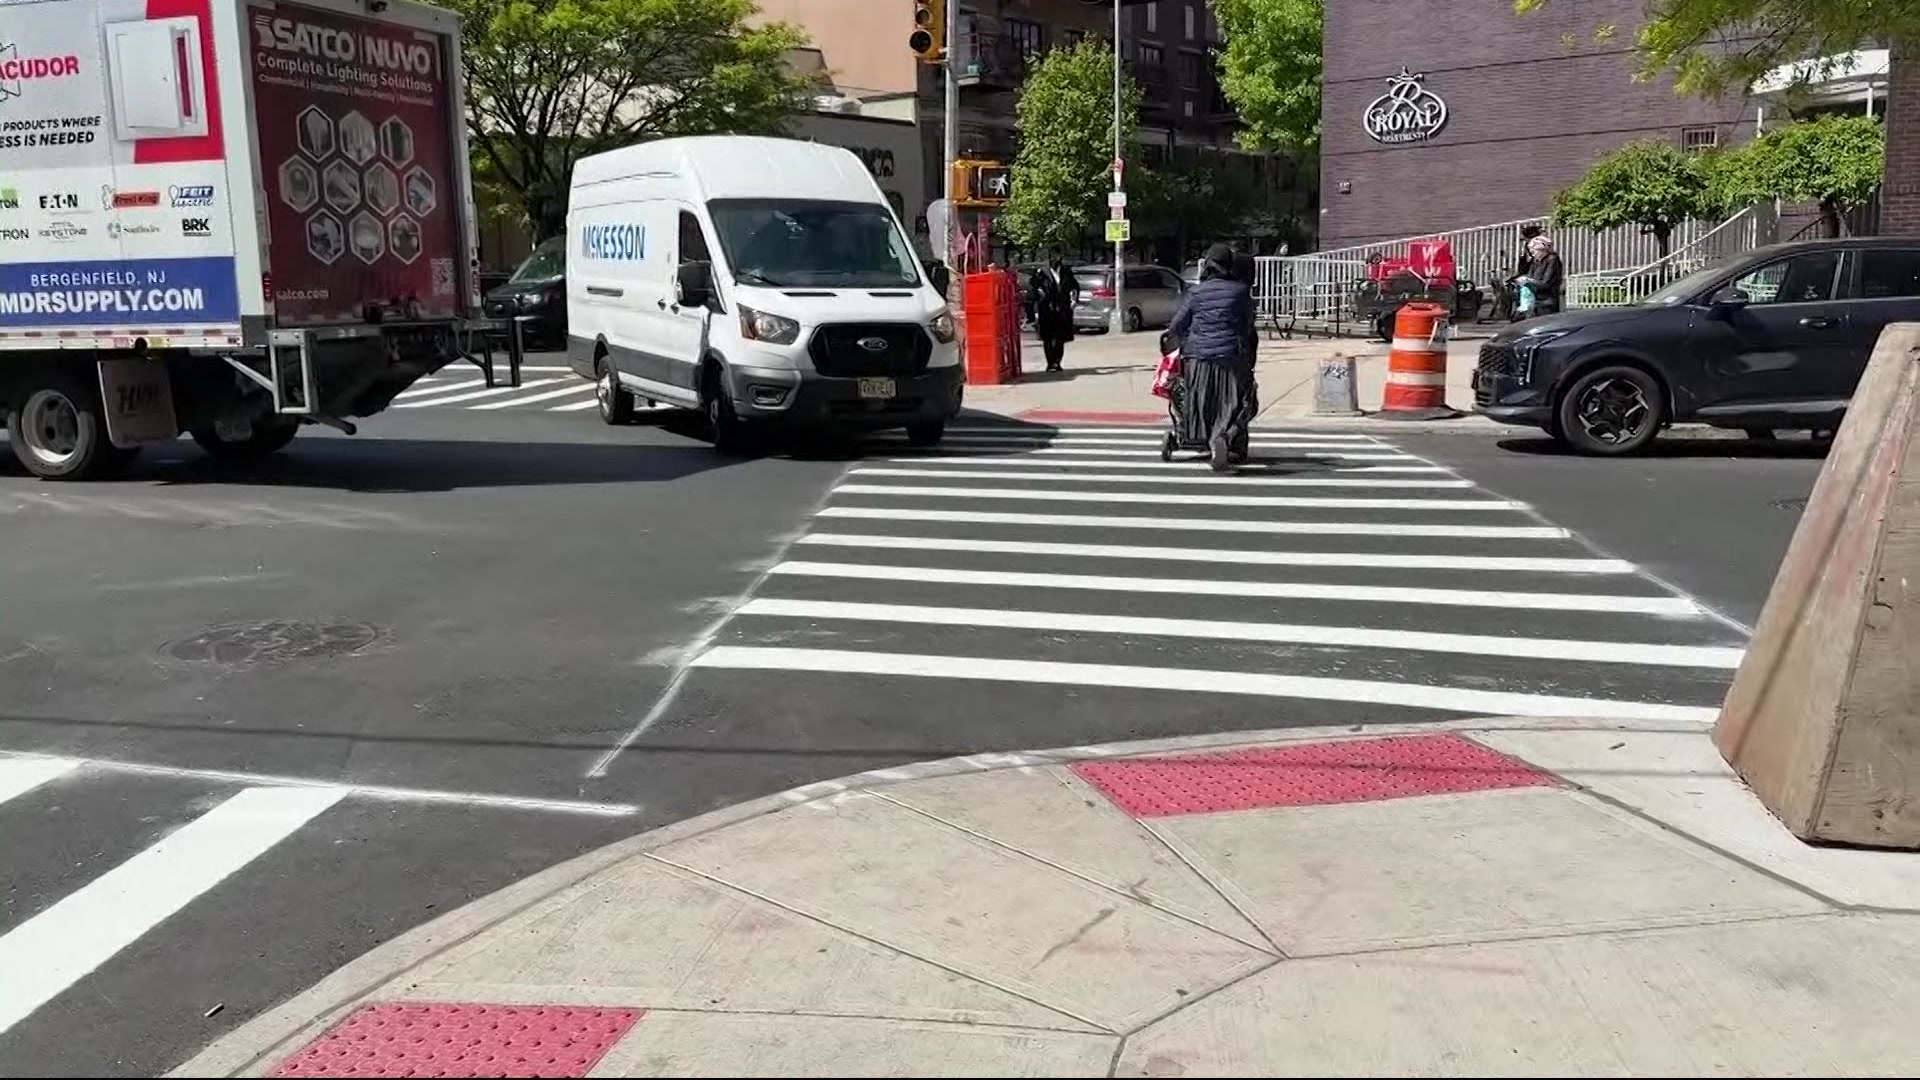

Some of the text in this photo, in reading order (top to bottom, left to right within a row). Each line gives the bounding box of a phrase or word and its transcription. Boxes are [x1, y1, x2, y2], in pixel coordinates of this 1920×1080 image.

[272, 17, 431, 75] SATCO NUVO
[256, 51, 433, 93] Complete Lighting Solutions
[3, 115, 101, 132] PRODUCTS WHERE
[1374, 109, 1437, 132] ROYAL
[24, 133, 36, 147] IS
[39, 130, 95, 147] NEEDED
[182, 187, 211, 198] FEIT
[182, 218, 209, 232] BRK
[30, 270, 166, 287] BERGENFIELD, NJ
[0, 287, 203, 314] MDRSUPPLY.COM
